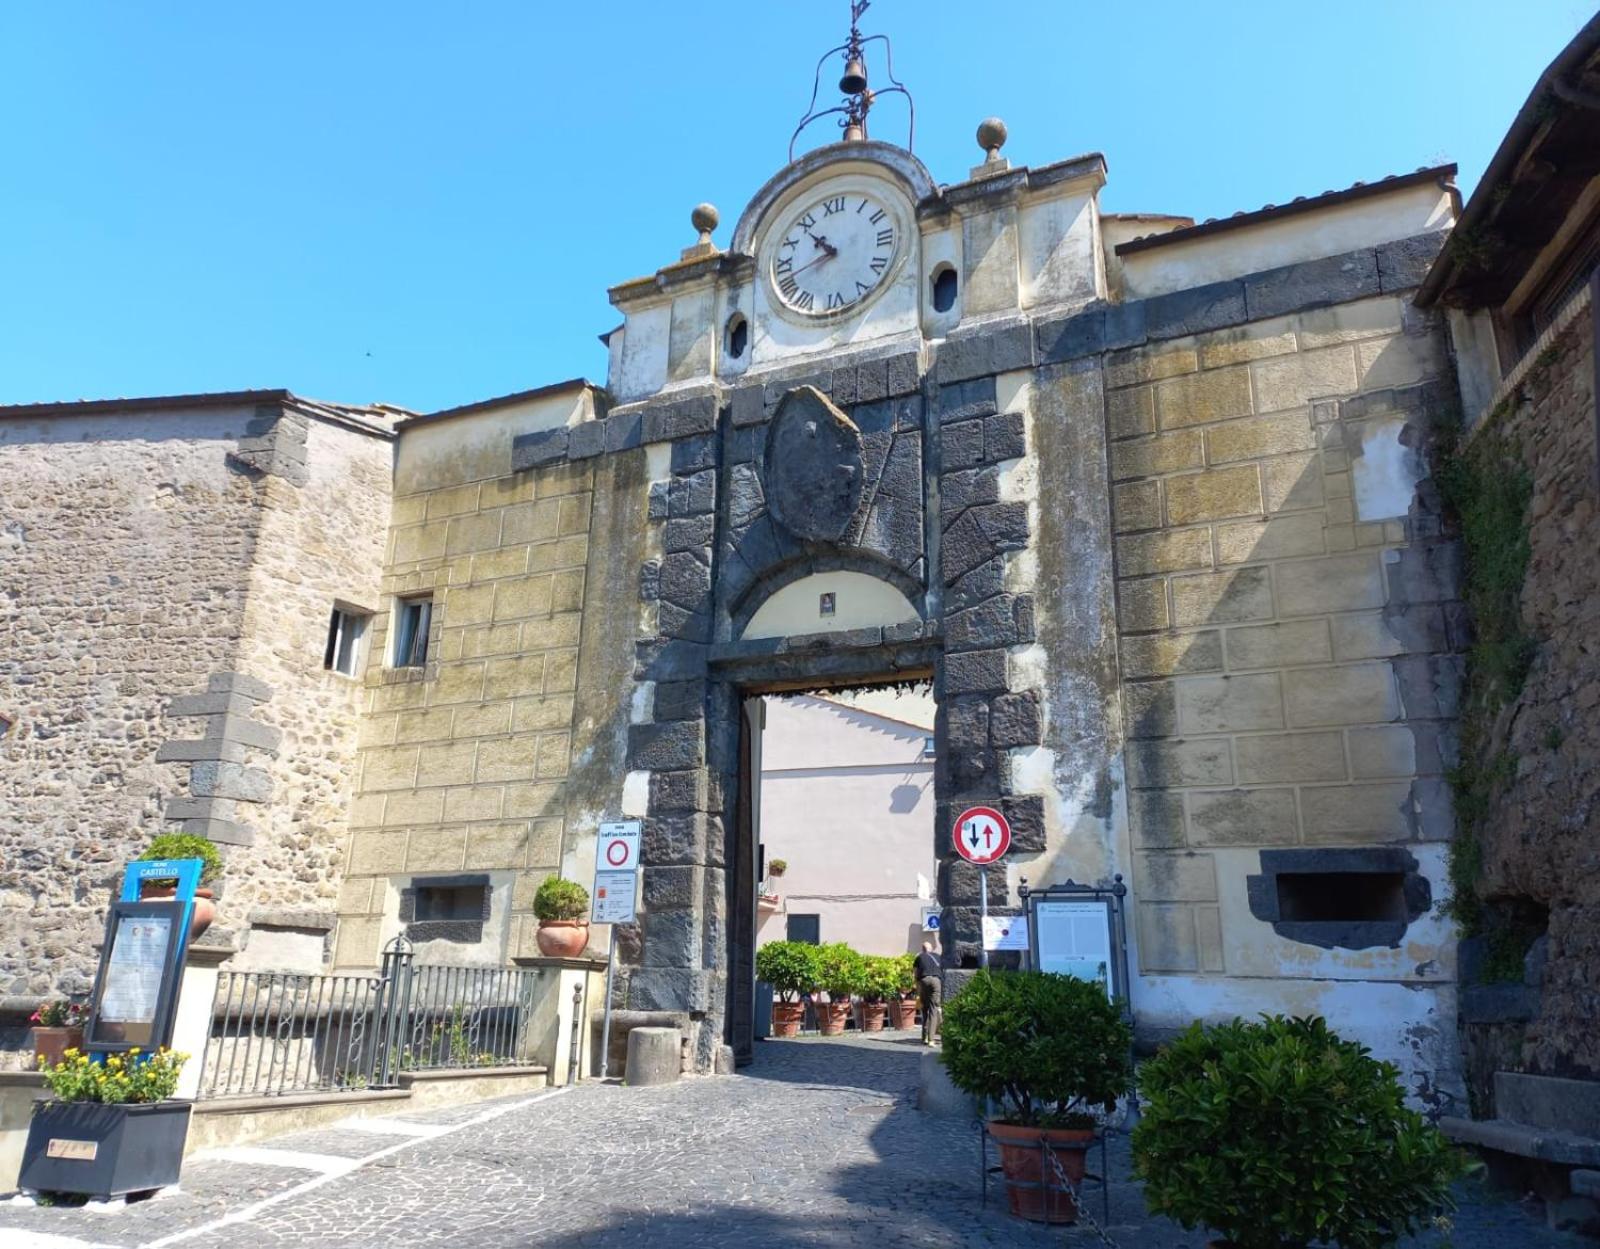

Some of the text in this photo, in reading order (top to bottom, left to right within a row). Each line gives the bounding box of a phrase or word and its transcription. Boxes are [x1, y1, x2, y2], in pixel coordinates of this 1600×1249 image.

[823, 196, 845, 217] XII
[856, 199, 868, 214] I
[797, 213, 816, 234] XI
[869, 208, 887, 225] II
[783, 236, 799, 250] X
[877, 228, 892, 248] III
[777, 257, 793, 275] IX
[870, 257, 888, 276] IV
[779, 276, 799, 300] VIII
[855, 281, 871, 296] V
[799, 291, 814, 309] VII
[827, 292, 845, 309] VI
[140, 868, 178, 877] CASTELLO
